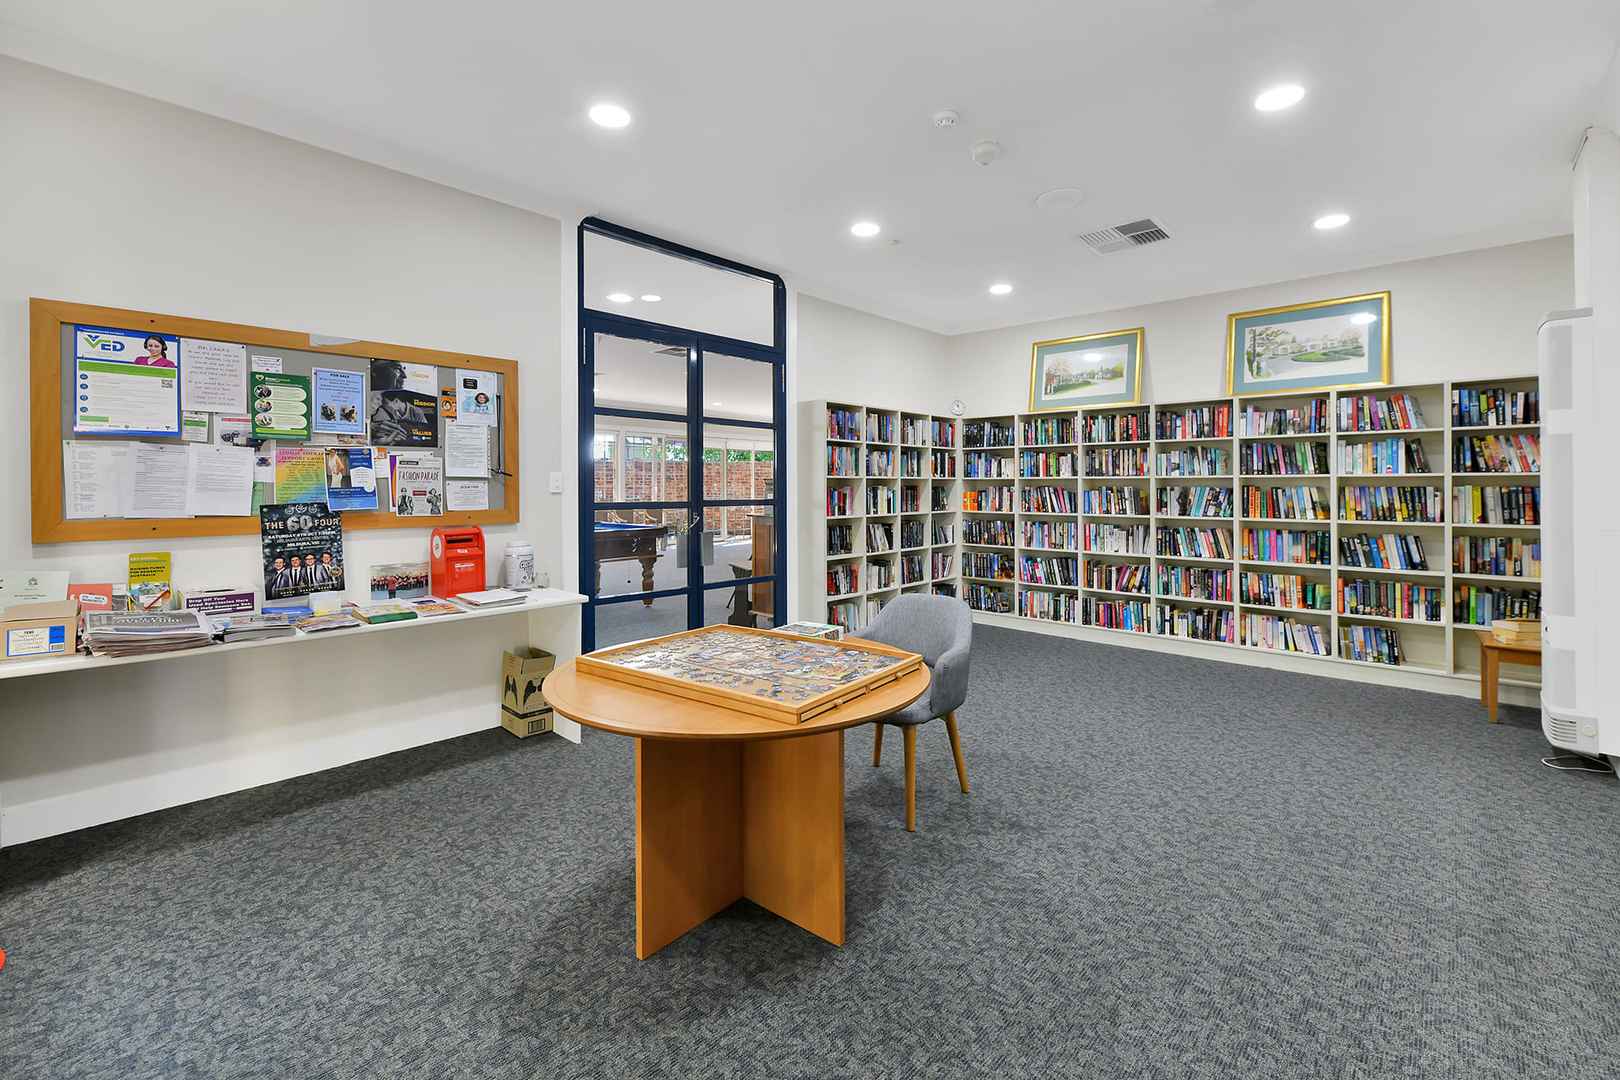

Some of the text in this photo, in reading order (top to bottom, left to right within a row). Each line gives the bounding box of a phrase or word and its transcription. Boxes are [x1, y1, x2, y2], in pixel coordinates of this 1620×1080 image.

[399, 470, 440, 481] FASHION PARADE
[264, 521, 284, 530] THE
[314, 518, 339, 528] FOUR
